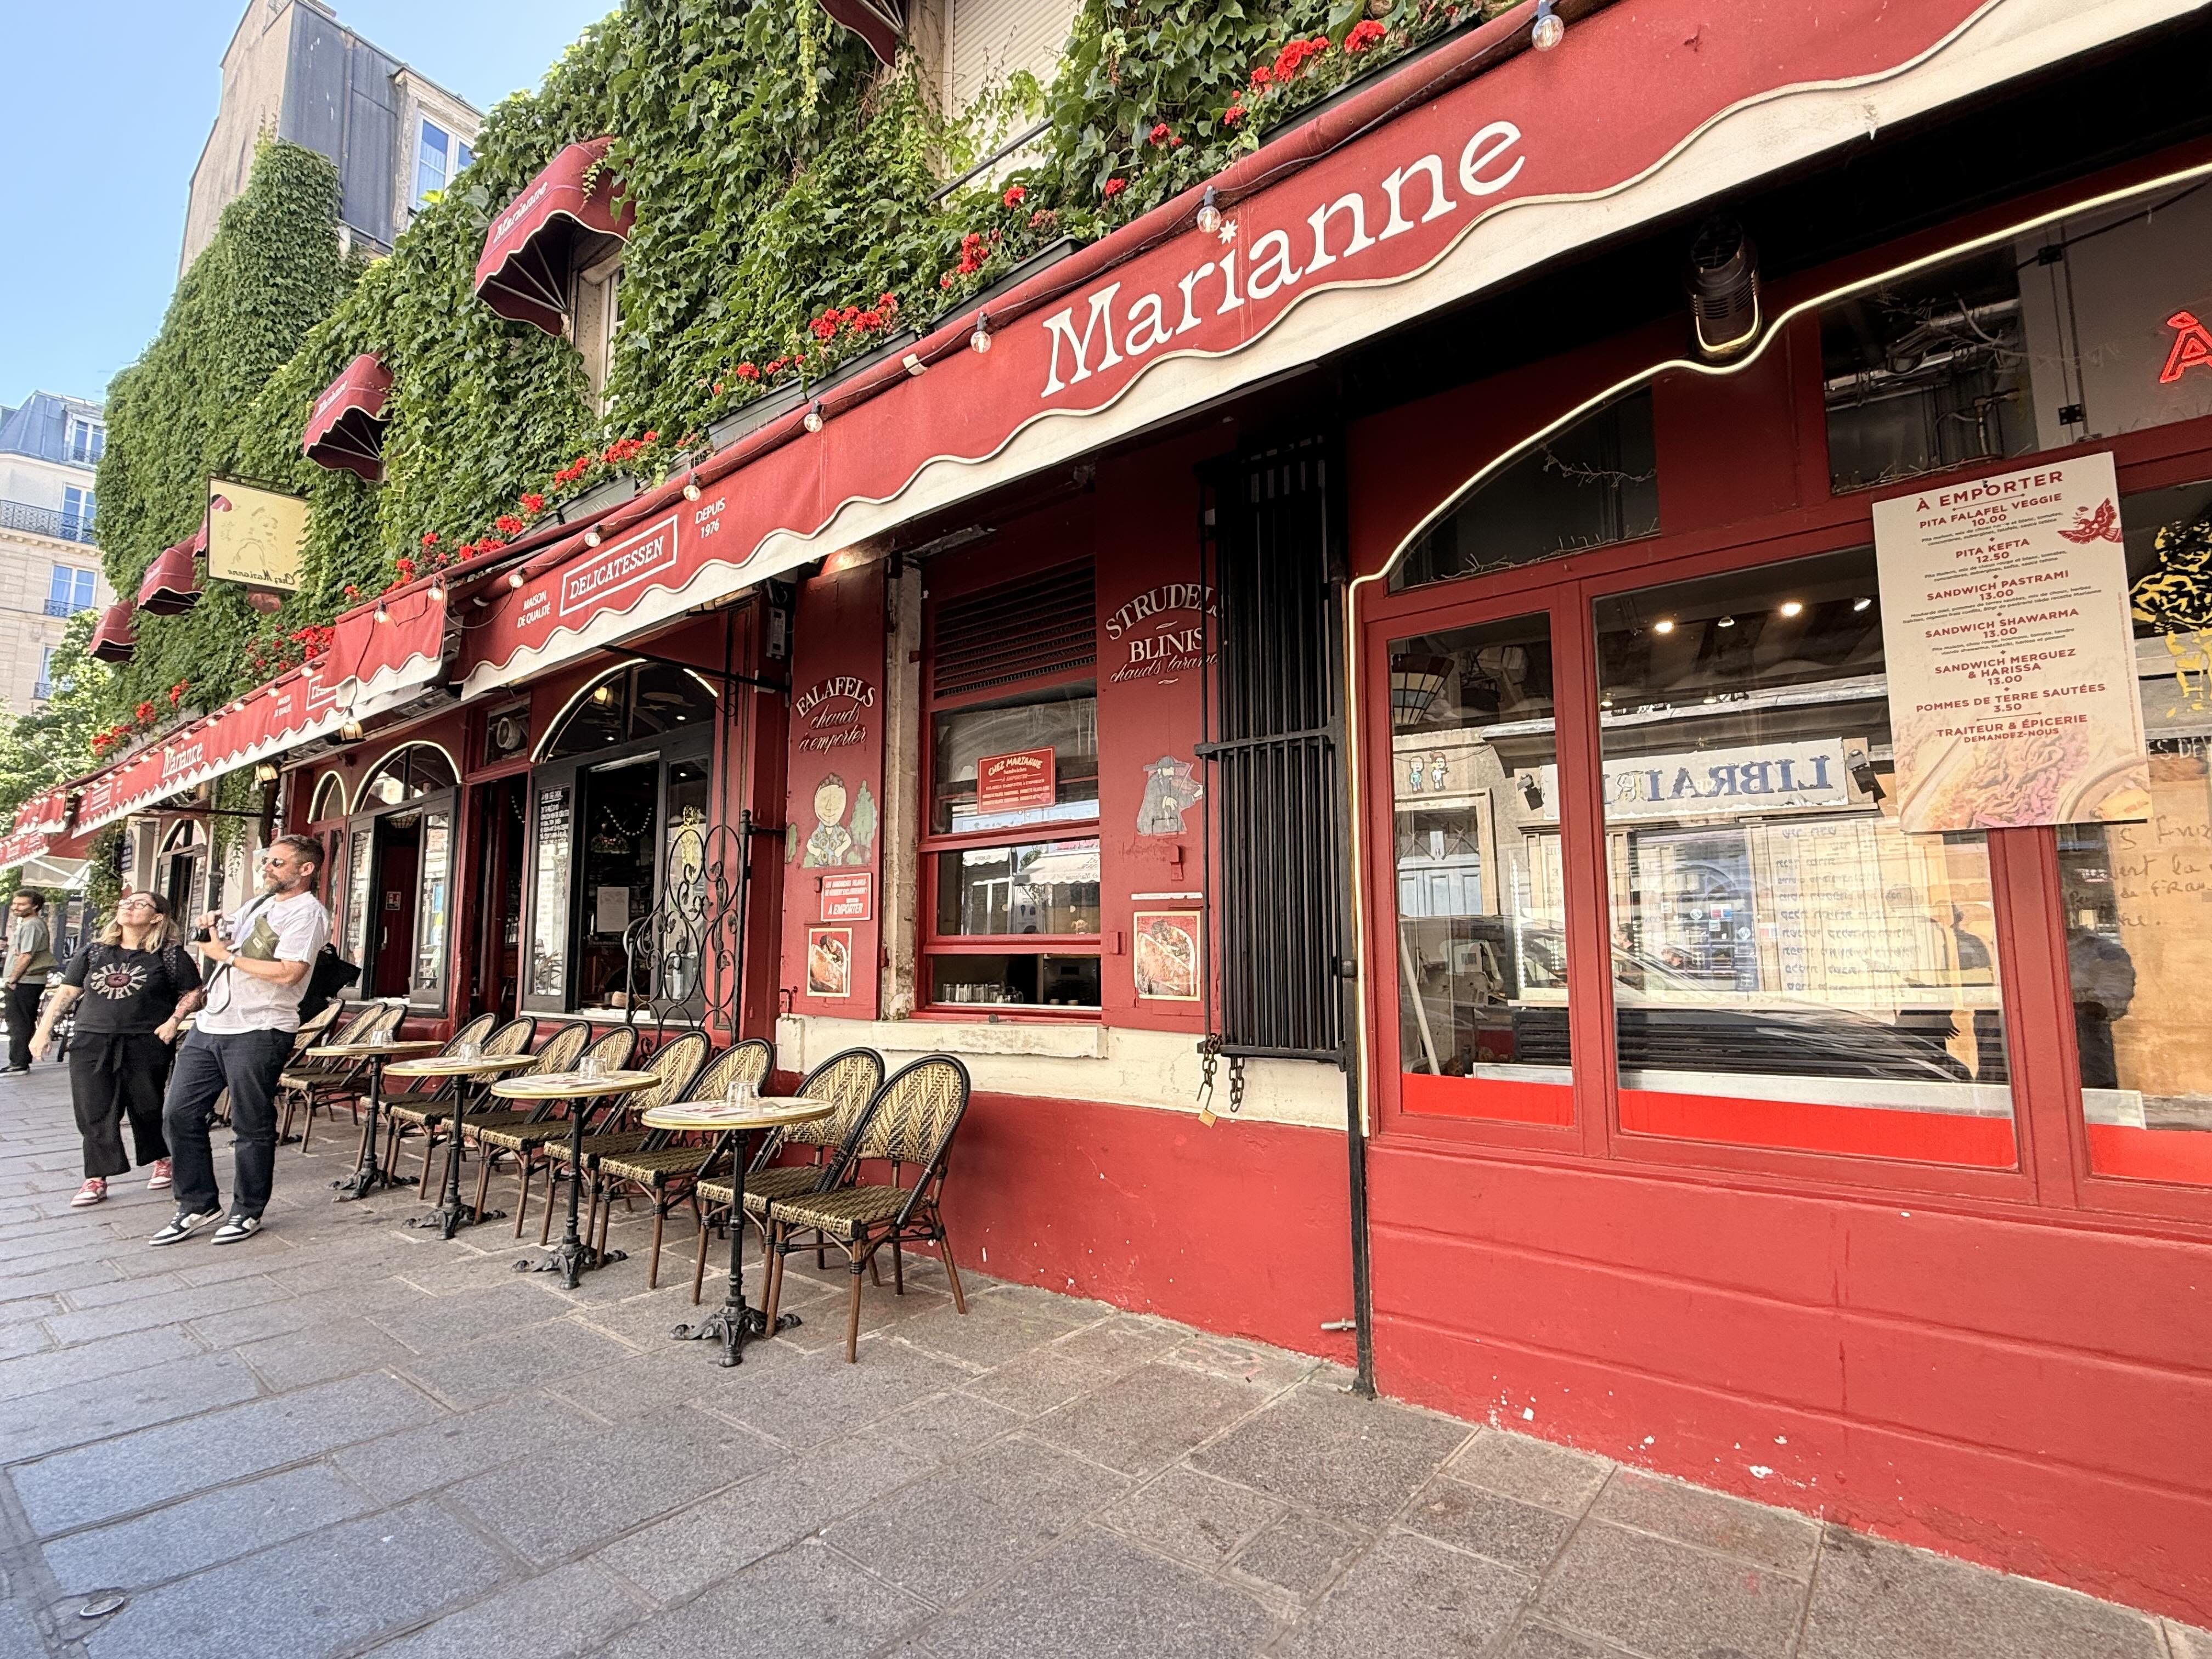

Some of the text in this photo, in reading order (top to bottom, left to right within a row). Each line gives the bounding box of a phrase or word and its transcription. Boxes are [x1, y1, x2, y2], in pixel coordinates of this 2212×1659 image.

[1041, 120, 1526, 398] Marianne
[1916, 471, 2063, 512] À EMPORTER
[695, 496, 726, 525] DEPUIS
[1920, 493, 2063, 529] PITA FALAFEL VEGGIE
[1972, 514, 2007, 527] 10.00
[701, 520, 720, 539] 1976
[1956, 538, 2030, 558] PITA KEFTA
[1976, 551, 2010, 563] 12.50
[569, 535, 665, 600] DELICATESSEN
[1927, 569, 2069, 601] SANDWICH PASTRAMI
[1979, 589, 2014, 601] 13.00
[523, 590, 546, 612] MAISON
[1106, 584, 1217, 640] STRUDEL
[517, 617, 526, 629] DE
[1925, 608, 2079, 639] SANDWICH SHAWARMA
[1983, 627, 2018, 639] 13.00
[1110, 659, 1162, 682] chauds
[1935, 648, 2076, 674] SANDWICH MERGUEZ
[1968, 663, 2041, 679] & HARISSA
[1988, 675, 2023, 686] 13.00
[796, 676, 876, 719] FALAFELS
[1916, 683, 2106, 712] POMMES DE TERRE SAUTÉES
[1994, 703, 2023, 713] 3.50
[1936, 723, 2004, 737] TRAITEUR
[2022, 714, 2088, 729] ÉPICERIE
[1963, 727, 2059, 743] DEMANDEZ-NOUS
[810, 724, 867, 755] emporter
[989, 757, 1043, 776] CHEZ MARIANNE
[827, 902, 863, 915] À EMPORTER
